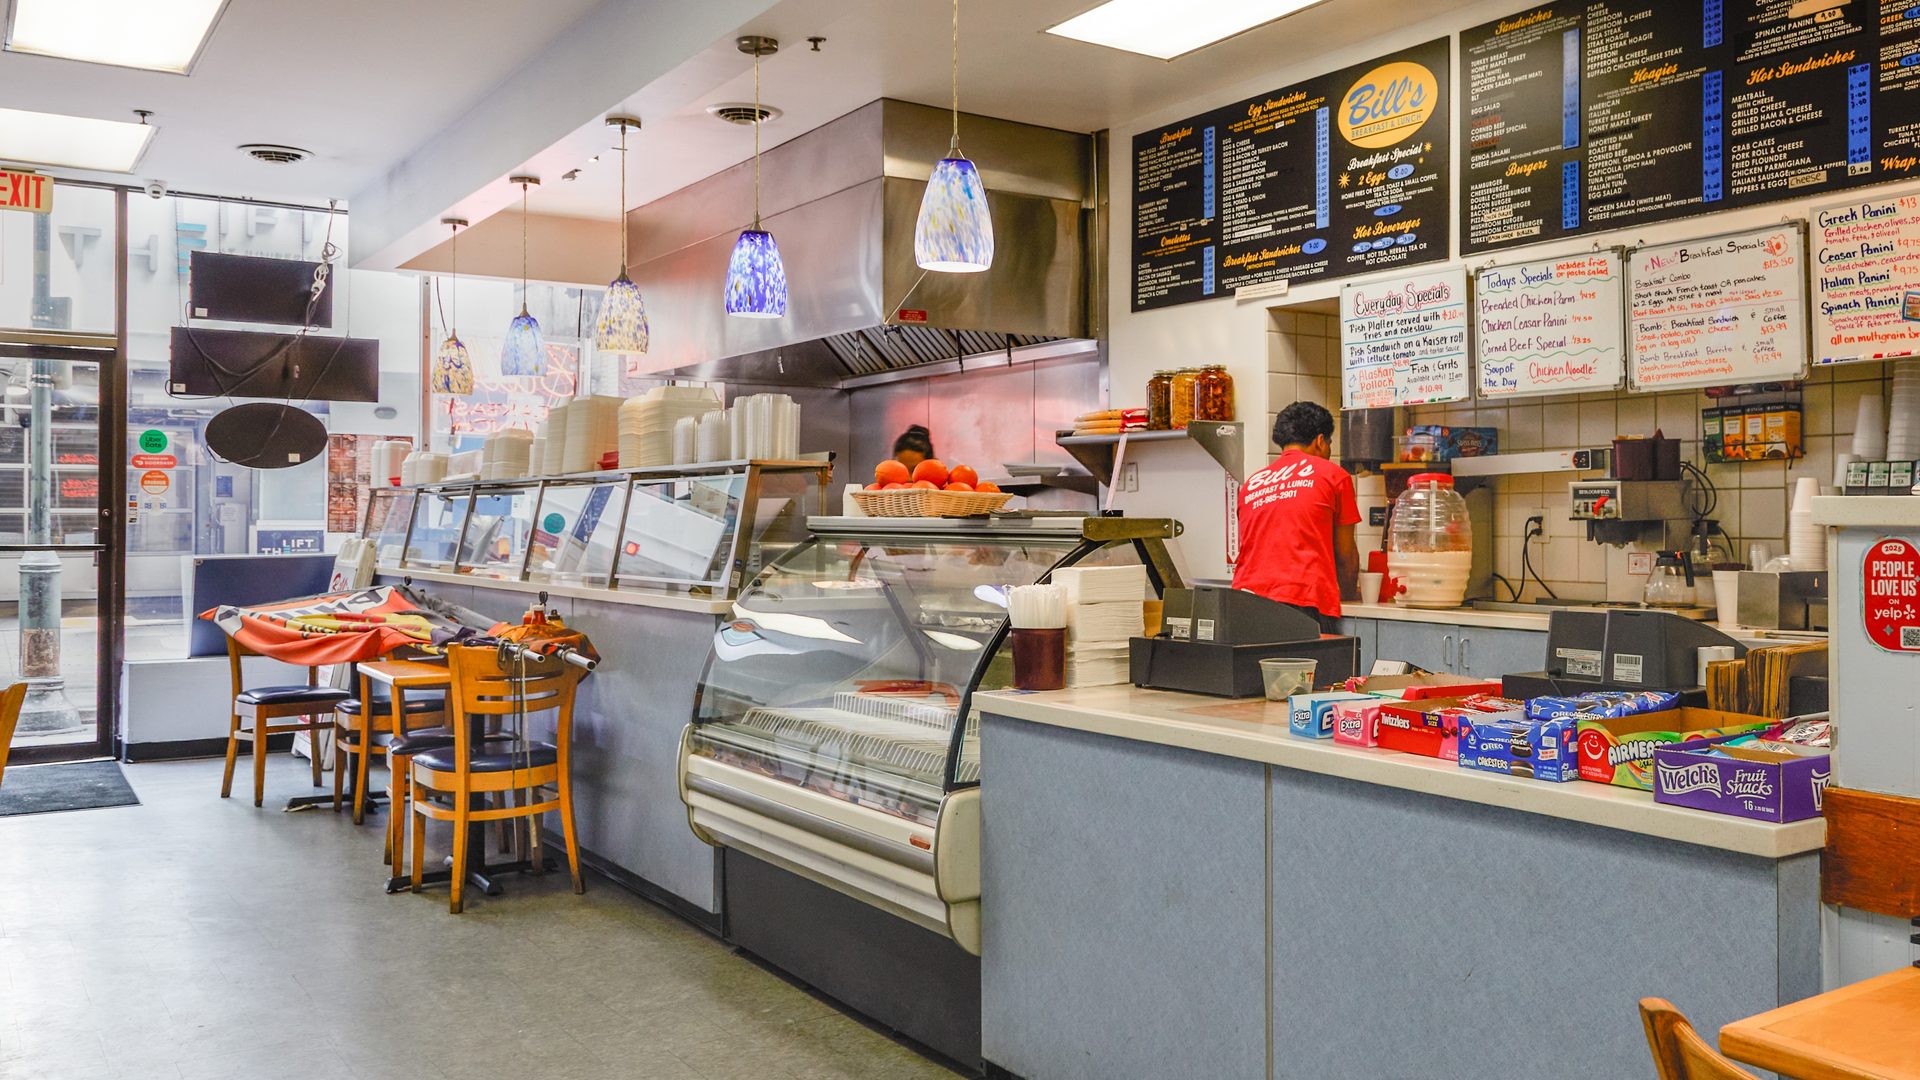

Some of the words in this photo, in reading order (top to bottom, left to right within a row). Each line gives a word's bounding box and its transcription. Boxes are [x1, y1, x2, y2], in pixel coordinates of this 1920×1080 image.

[1495, 10, 1552, 35] Sandwiches
[1880, 13, 1903, 25] GREEK
[1755, 25, 1785, 39] SPINACH
[1788, 19, 1813, 31] PANINI
[1587, 44, 1607, 56] CHEESE
[1609, 39, 1626, 50] STEAK
[1628, 32, 1653, 45] HOAGIE
[1587, 66, 1611, 78] BUFFALO
[1613, 59, 1639, 71] CHICKEN
[1641, 53, 1663, 64] CHEESE
[1664, 48, 1682, 58] STEAK
[1746, 68, 1774, 85] Hot
[1775, 50, 1855, 79] Sandwiches
[1630, 62, 1677, 83] Hoagies
[1248, 102, 1262, 118] Egg
[1264, 91, 1306, 111] Sandwiches
[1348, 76, 1427, 126] Bill's
[1588, 99, 1620, 111] AMERICAN
[1732, 90, 1765, 103] MEATBALL
[1737, 101, 1751, 109] WITH
[1752, 96, 1773, 106] CHEESE
[1732, 107, 1758, 119] GRILLED
[1760, 101, 1786, 113] CHEESE
[1732, 115, 1758, 127] GRILLED
[1760, 112, 1776, 121] HAM
[1786, 104, 1812, 115] CHEESE
[1351, 121, 1390, 138] BREAKFAST
[1390, 121, 1396, 129] &
[1397, 113, 1422, 127] LUNCH
[1732, 124, 1758, 135] GRILLED
[1760, 118, 1786, 129] BACON
[1796, 111, 1822, 122] CHEESE
[1160, 127, 1192, 144] Breakfast
[1732, 143, 1750, 152] CRAB
[1752, 138, 1775, 148] CAKES
[1732, 151, 1749, 161] PORK
[1752, 148, 1767, 157] ROLL
[1777, 141, 1804, 152] CHEESE
[1348, 147, 1390, 171] Breakfast
[1391, 142, 1423, 161] Special
[1732, 160, 1750, 169] FRIED
[1752, 153, 1787, 165] FLOUNDER
[1506, 160, 1547, 176] Burgers
[1732, 166, 1762, 178] CHICKEN
[1765, 157, 1811, 172] PARMIGIANA
[1359, 175, 1364, 186] 2
[1366, 170, 1386, 187] Eggs
[1732, 184, 1758, 195] PEPPERS
[1768, 179, 1787, 189] EGGS
[1819, 208, 1857, 229] Greek
[1862, 204, 1897, 219] Panini
[1353, 226, 1372, 240] Hot
[1372, 218, 1420, 237] Beverages
[1160, 234, 1190, 248] Omelettes
[1223, 252, 1258, 268] Breakfast
[1259, 244, 1300, 262] Sandwiches
[1819, 247, 1858, 265] Ceasar
[1860, 242, 1894, 256] Panini
[1482, 272, 1516, 289] Todays
[1520, 266, 1552, 285] Specials
[1820, 276, 1855, 292] Italian
[1858, 270, 1890, 284] Panini
[1355, 291, 1402, 316] Everyday
[1405, 283, 1450, 309] Specials
[1482, 299, 1518, 314] Breaded
[1520, 293, 1553, 309] Chicken
[1553, 290, 1575, 306] Parm
[1821, 300, 1861, 316] Spinach
[1865, 293, 1900, 309] Panini
[1350, 324, 1366, 334] Fish
[1396, 314, 1420, 326] served
[1481, 319, 1512, 334] Chicken
[1543, 312, 1568, 328] Panini
[1384, 328, 1398, 337] and
[1830, 334, 1842, 346] all
[1844, 336, 1855, 344] on
[1858, 330, 1906, 344] multigrain
[1350, 346, 1364, 357] Fish
[1366, 340, 1400, 353] Sandwich
[1404, 342, 1414, 350] on
[1422, 336, 1447, 346] Kaiser
[1450, 332, 1464, 343] roll
[1509, 338, 1533, 352] Beef
[1536, 336, 1566, 351] Special
[1350, 356, 1365, 366] with
[1392, 350, 1416, 359] tomato
[1359, 367, 1395, 381] Alaskan
[1410, 363, 1429, 374] Fish
[1484, 363, 1504, 376] Soup
[1529, 362, 1564, 379] Chicken
[1565, 362, 1592, 375] Noodle
[1360, 378, 1394, 391] Pollock
[1484, 377, 1497, 388] the
[1502, 378, 1518, 388] Day
[1247, 459, 1314, 491] Bill's
[1244, 485, 1278, 504] BREAKFAST
[1287, 480, 1314, 488] LUNCH
[282, 539, 314, 548] LIFT
[1872, 561, 1914, 577] PEOPLE
[1872, 580, 1899, 596] LOVE
[1901, 580, 1916, 596] US
[1874, 607, 1902, 620] yelp
[1294, 710, 1310, 722] Extra
[1381, 712, 1410, 730] Twizzlers
[1426, 714, 1438, 722] KING
[1341, 720, 1362, 731] Extra
[1480, 743, 1504, 751] OREO
[1477, 756, 1508, 770] CAKESTERS
[1661, 763, 1718, 791] Welch's
[1736, 770, 1767, 782] Fruit
[1726, 780, 1772, 796] Snacks
[1744, 800, 1754, 810] 16
